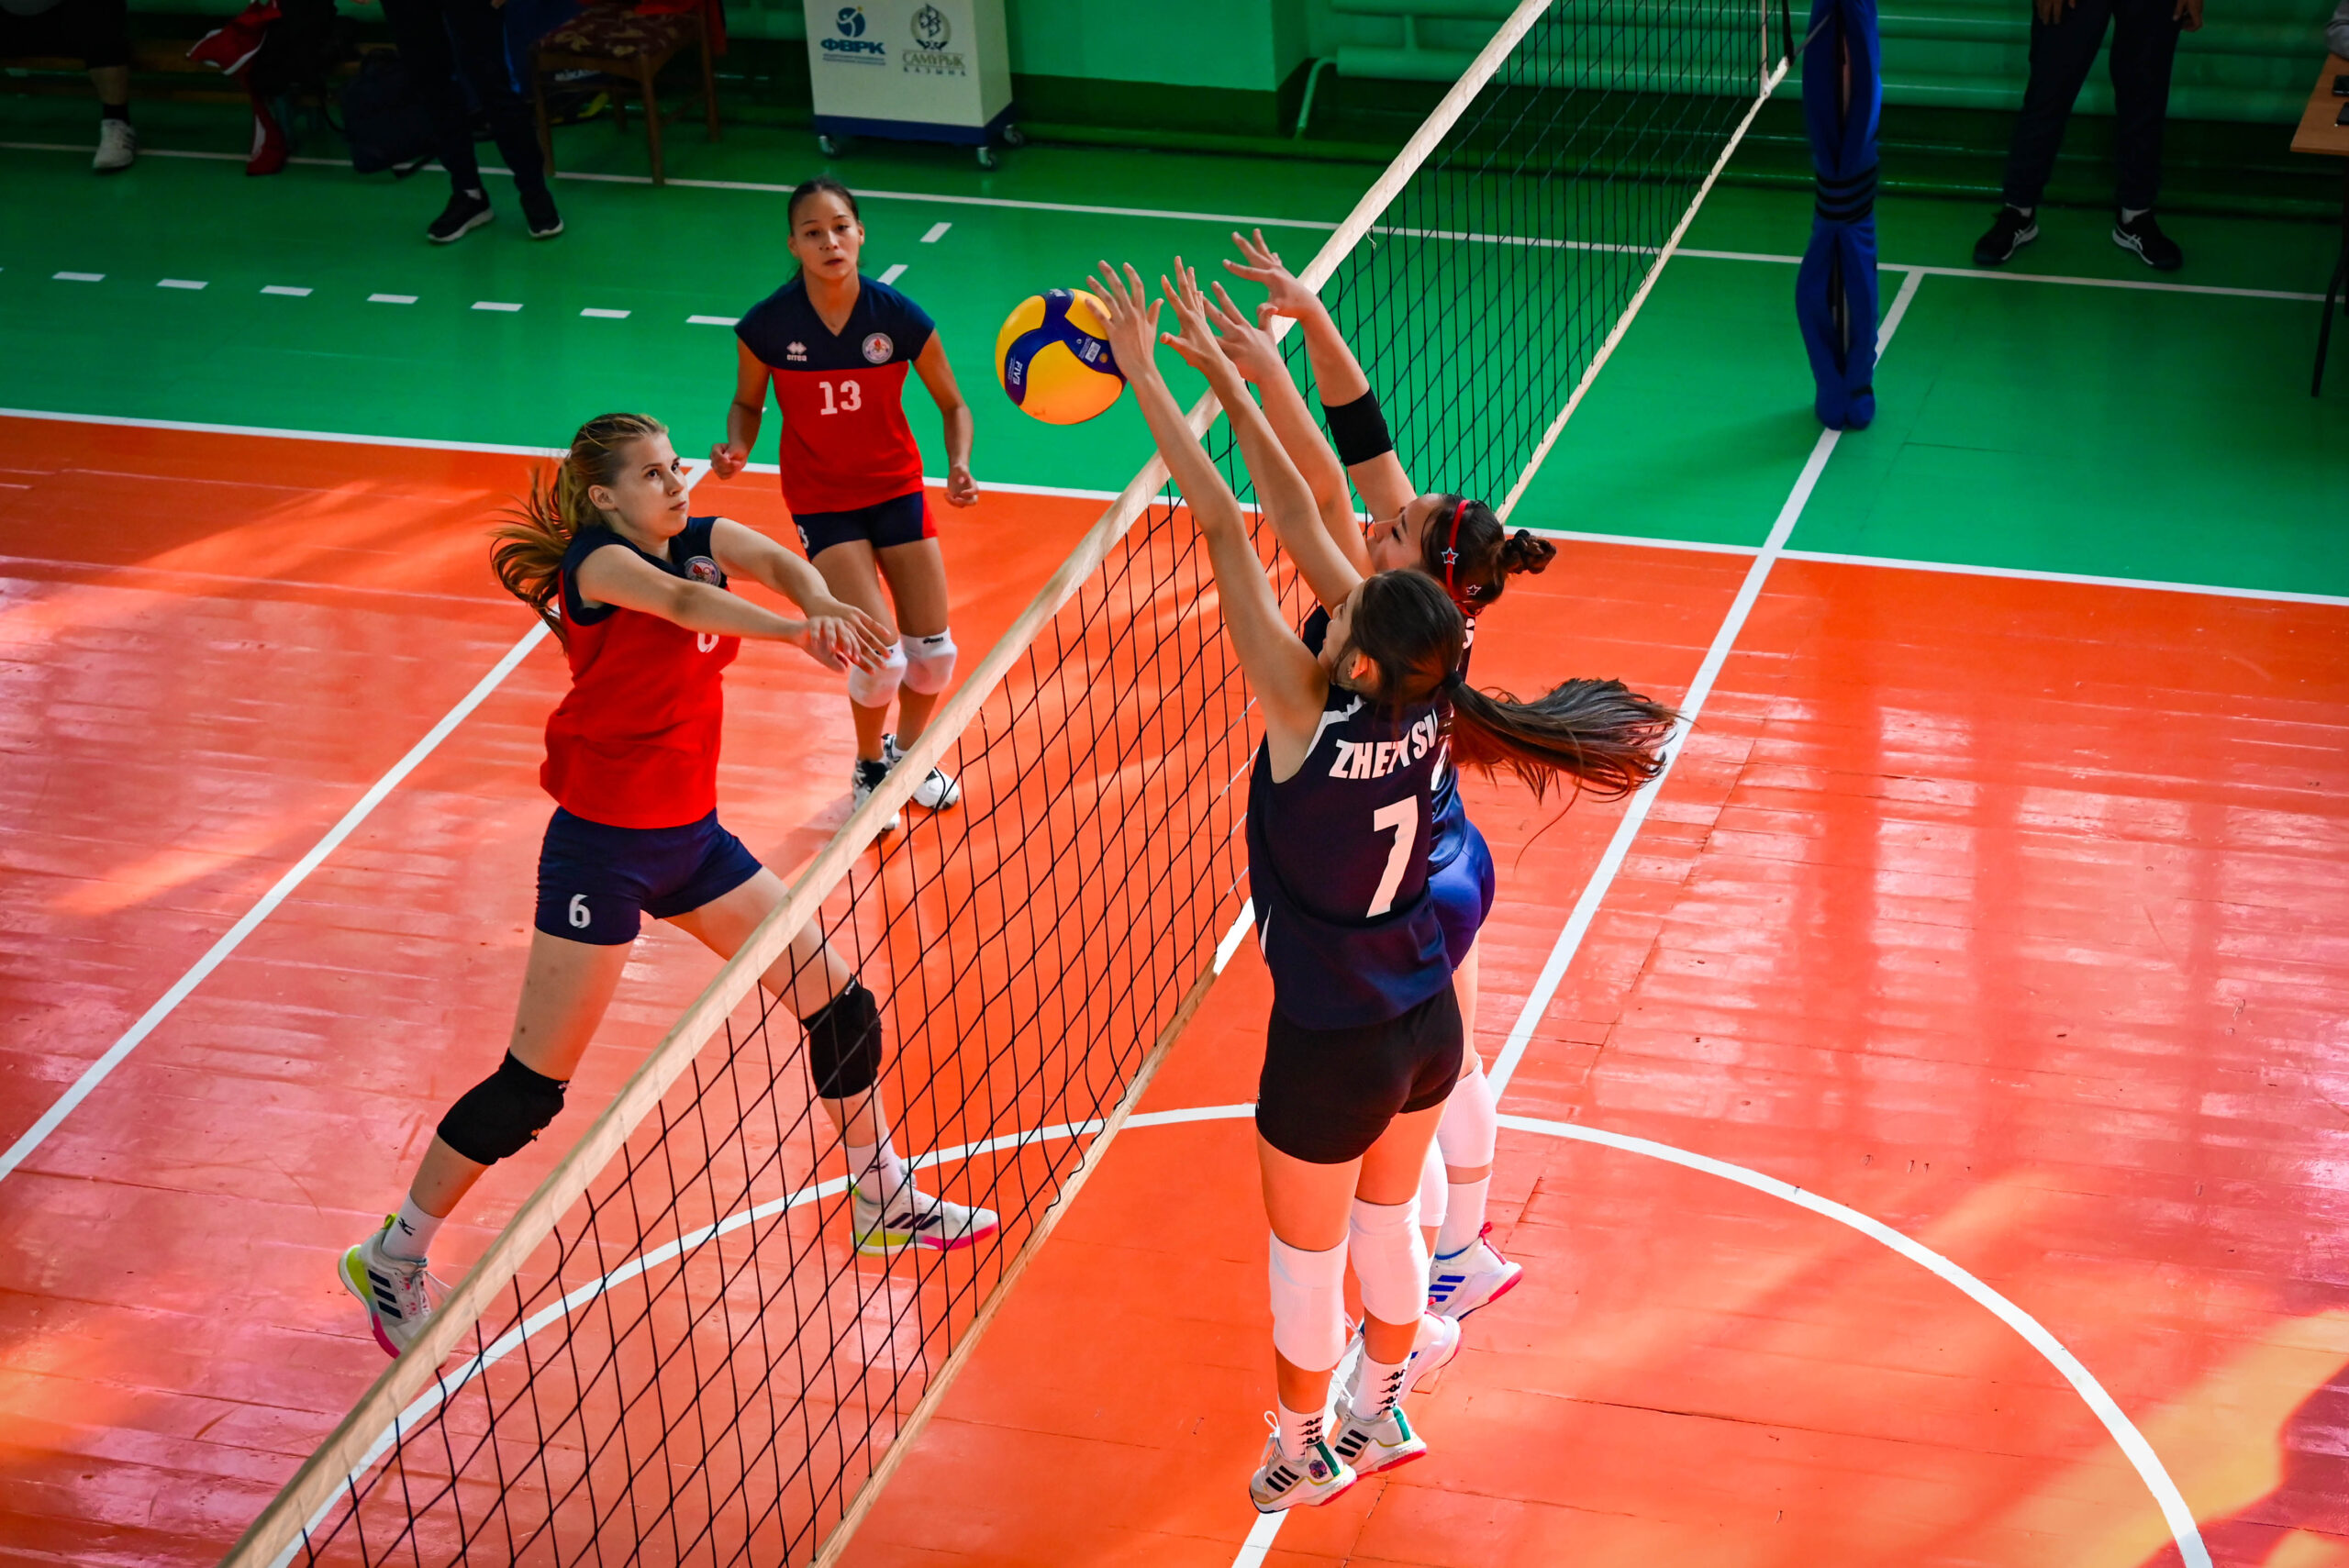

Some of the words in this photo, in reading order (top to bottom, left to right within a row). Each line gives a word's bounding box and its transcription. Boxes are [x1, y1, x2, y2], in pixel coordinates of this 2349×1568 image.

[820, 38, 886, 55] ФВРК
[819, 380, 862, 416] 13
[1365, 794, 1419, 918] 7
[568, 892, 588, 929] 6
